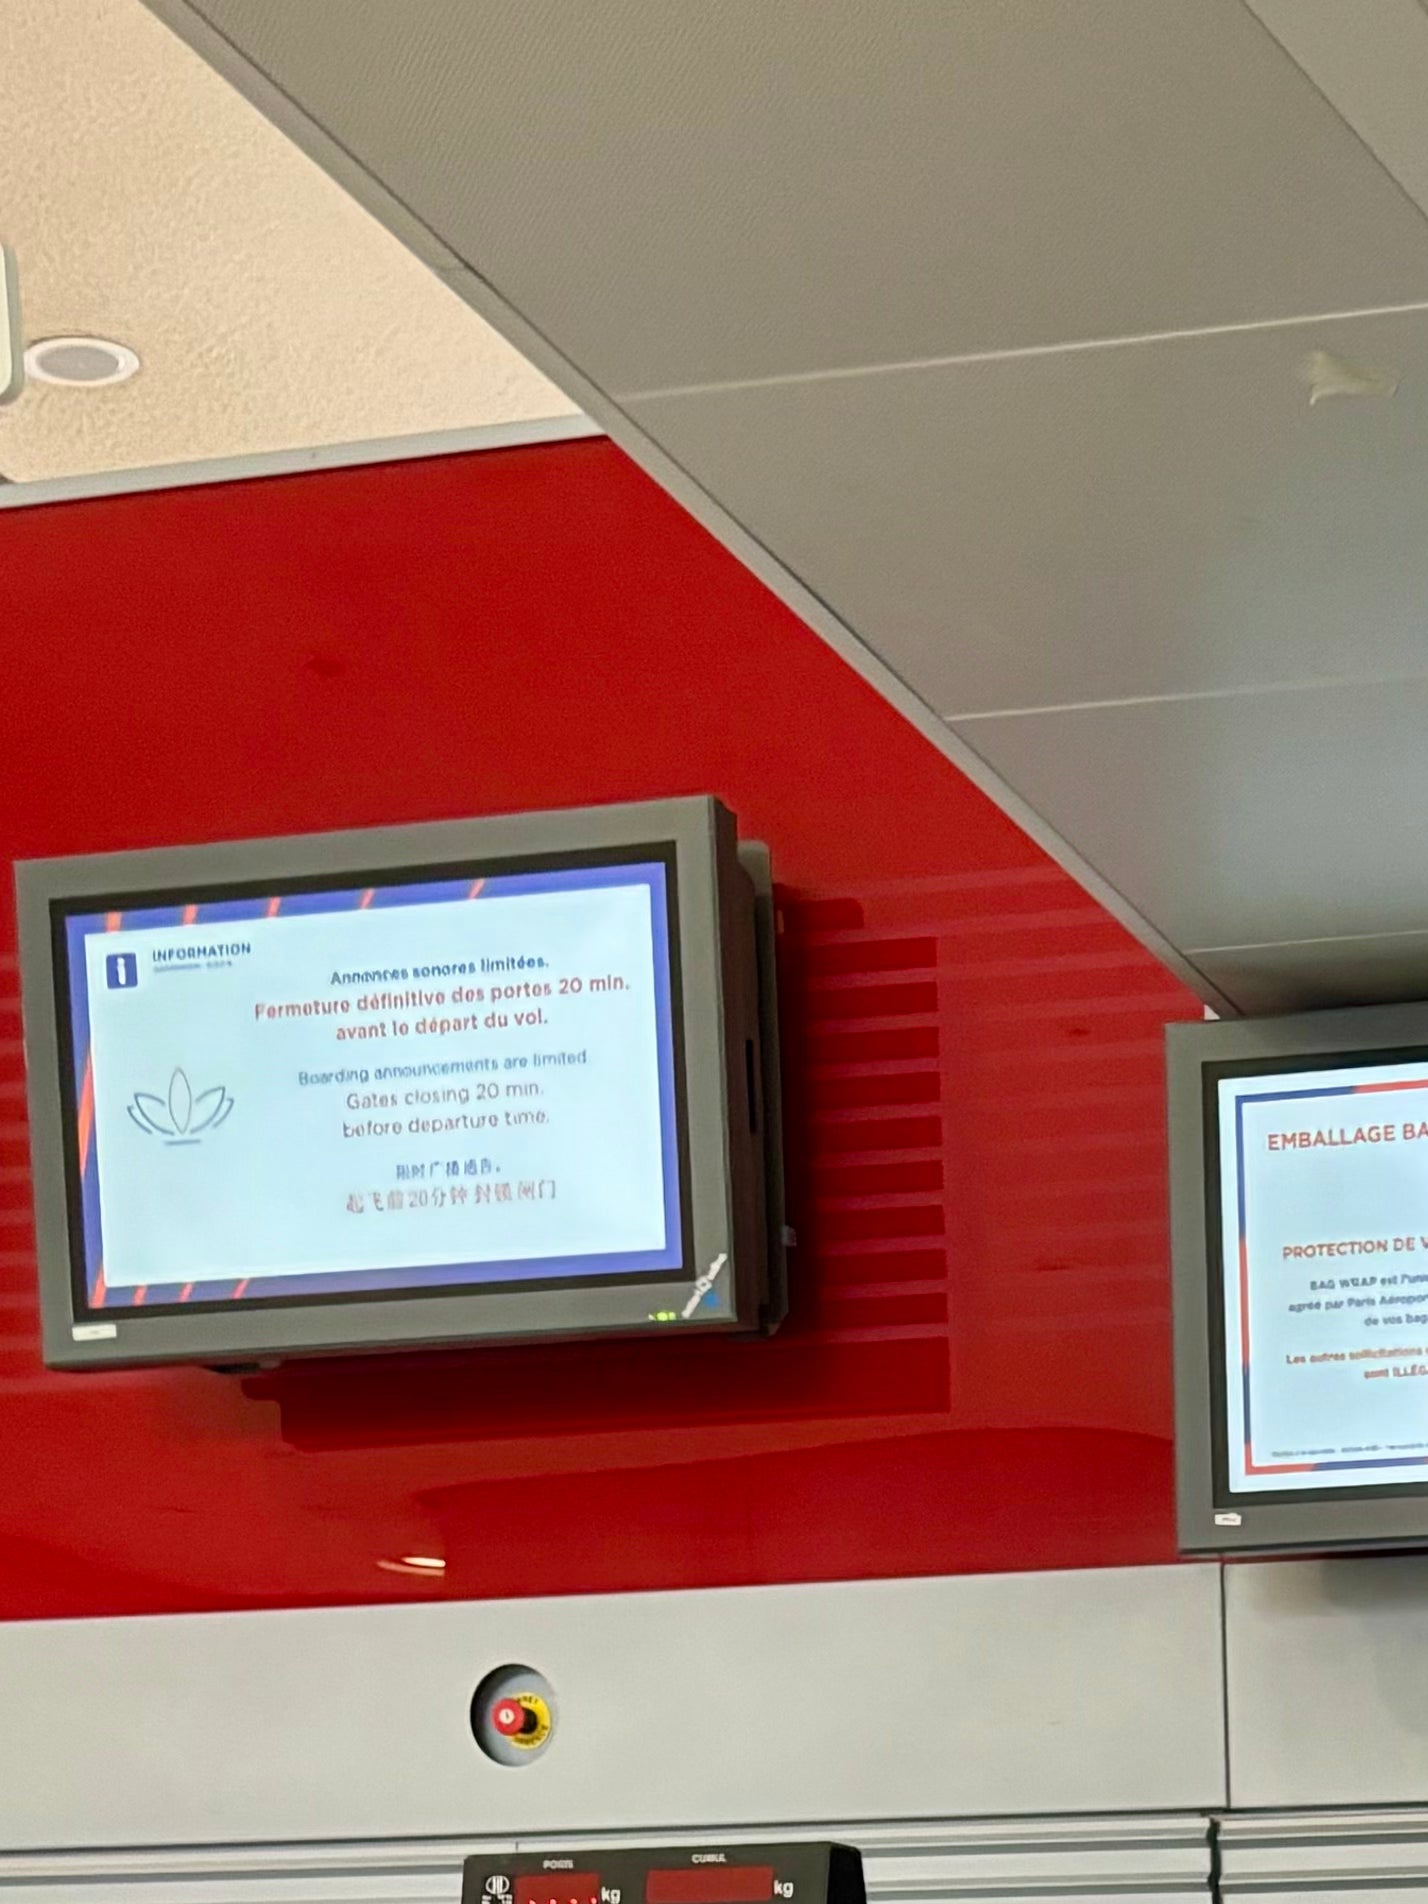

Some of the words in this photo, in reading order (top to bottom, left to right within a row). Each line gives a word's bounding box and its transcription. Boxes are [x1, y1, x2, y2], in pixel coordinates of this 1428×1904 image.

[152, 942, 251, 963] INFORMATION
[559, 976, 582, 995] 20
[589, 974, 630, 992] min.
[336, 1022, 387, 1040] avant
[484, 1011, 508, 1029] du
[514, 1008, 548, 1026] vol.
[299, 1067, 370, 1086] Boarding
[503, 1056, 528, 1070] are
[346, 1092, 398, 1110] Gates
[404, 1086, 470, 1106] closing
[476, 1083, 499, 1101] 20
[342, 1119, 402, 1138] before
[408, 1112, 498, 1135] departure
[1267, 1125, 1396, 1151] EMBALLAGE
[1282, 1239, 1388, 1260] PROTECTION
[1393, 1236, 1415, 1252] DE
[1310, 1279, 1336, 1291] BAG
[1339, 1276, 1377, 1289] WRAP
[773, 1879, 794, 1899] kg
